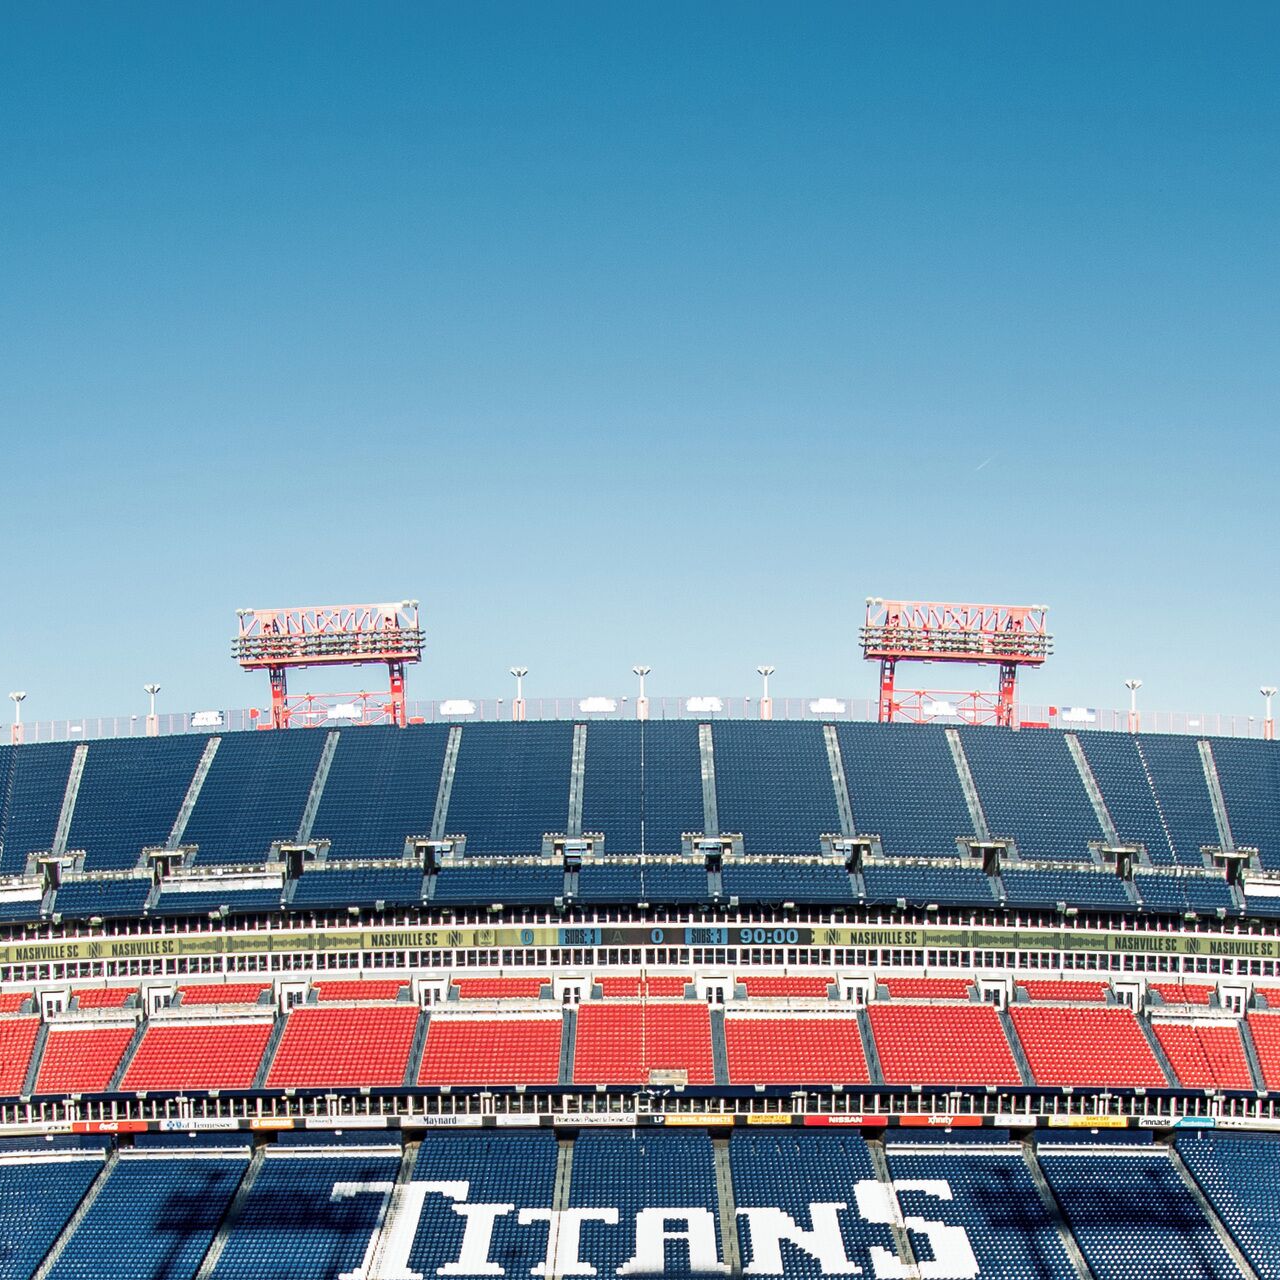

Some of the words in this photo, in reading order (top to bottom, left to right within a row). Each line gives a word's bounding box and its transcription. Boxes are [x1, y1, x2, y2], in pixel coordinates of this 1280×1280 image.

[371, 932, 422, 947] NASHVILLE
[425, 931, 438, 945] SC
[740, 928, 799, 944] 90:00
[850, 931, 902, 945] NASHVILLE
[905, 930, 917, 944] SC
[1115, 937, 1164, 950] NASHVILLE
[1165, 939, 1177, 950] SC
[16, 947, 65, 960] NASHVILLE
[67, 945, 78, 958] SC
[112, 943, 160, 956] NASHVILLE
[162, 940, 174, 953] SC
[1210, 941, 1259, 955] NASHVILLE
[1261, 943, 1273, 955] SC
[423, 1116, 457, 1127] Maynard
[329, 1179, 981, 1280] TITANS
